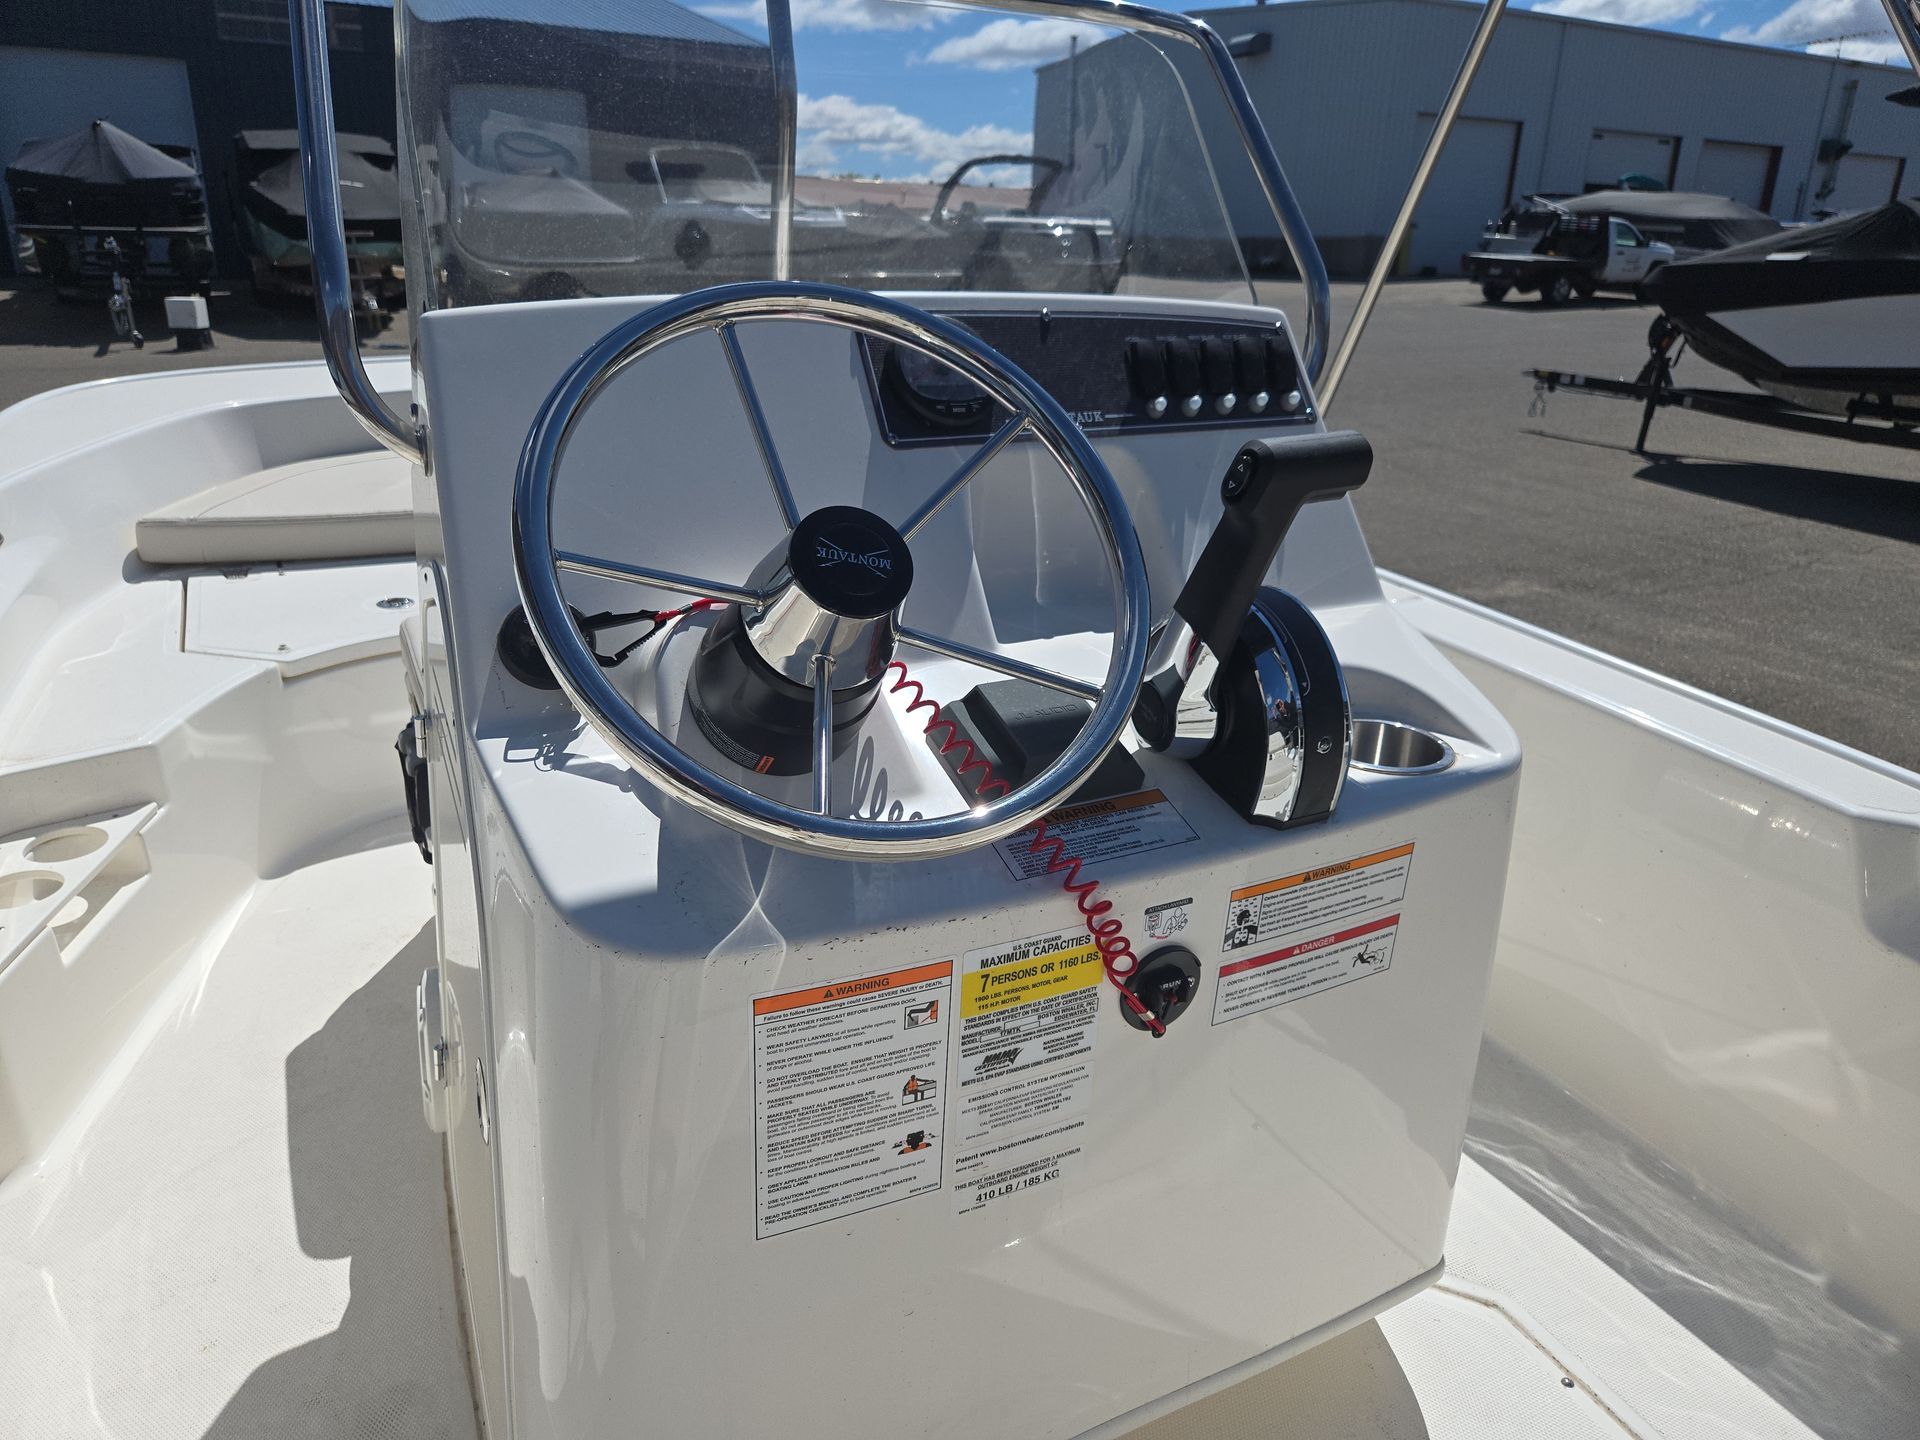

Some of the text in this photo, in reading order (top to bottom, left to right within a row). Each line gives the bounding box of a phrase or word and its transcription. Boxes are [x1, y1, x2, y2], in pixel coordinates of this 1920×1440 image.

[816, 546, 892, 570] MONTAUK
[1035, 704, 1078, 716] AUDIO
[1052, 802, 1116, 821] WARNING
[1312, 862, 1350, 879] WARNING
[980, 934, 1090, 969] MAXIMUM CAPACITIES
[1024, 939, 1041, 948] COAST
[1043, 935, 1061, 943] GUARD
[1300, 935, 1335, 952] DANGER
[980, 950, 1100, 992] 7 PERSONS OR 1160 LBS.
[837, 978, 889, 995] WARNING
[1003, 984, 1030, 995] PERSONS,
[1052, 975, 1067, 983] GEAR
[1162, 980, 1182, 990] RUN
[764, 1013, 781, 1022] Failure
[789, 1008, 805, 1016] follow
[806, 1005, 820, 1013] these
[822, 1000, 845, 1010] warnings
[846, 997, 860, 1005] could
[862, 994, 876, 1002] cause
[878, 989, 898, 998] SEVERE
[899, 985, 917, 994] INJURY
[787, 1019, 814, 1028] WEATHER
[816, 1013, 845, 1022] FORECAST
[846, 1008, 868, 1016] BEFORE
[870, 1001, 899, 1011] DEPARTING
[900, 997, 915, 1005] DOCK
[964, 1019, 994, 1031] STANDARDS
[1002, 1012, 1020, 1021] EFFECT
[1030, 1006, 1039, 1014] THE
[1062, 992, 1097, 1005] CERTIFICATION
[965, 1016, 976, 1024] THIS
[992, 1006, 1018, 1017] COMPLIES
[1019, 1002, 1031, 1010] WITH
[1043, 996, 1059, 1004] COAST
[1060, 991, 1077, 999] GUARD
[1079, 986, 1096, 994] SAFETY
[978, 1003, 988, 1011] 115
[1000, 995, 1020, 1004] MOTOR
[1037, 1010, 1059, 1019] BOSTON
[766, 1032, 833, 1050] WEAR SAFETY LANYARD
[787, 1053, 812, 1062] OPERATE
[832, 1044, 851, 1052] UNDER
[864, 1035, 892, 1045] INFLUENCE
[776, 1074, 788, 1082] NOT
[789, 1068, 819, 1078] OVERLOAD
[873, 1052, 886, 1060] THAT
[888, 1048, 907, 1056] WEIGHT
[915, 1040, 941, 1050] PROPERLY
[767, 1092, 803, 1104] PASSENGERS
[805, 1086, 827, 1095] SHOULD
[829, 1082, 844, 1090] WEAR
[876, 1071, 894, 1079] GUARD
[896, 1064, 923, 1074] APPROVED
[780, 1077, 801, 1085] EVENLY
[802, 1069, 837, 1080] DISTRIBUTED
[968, 1065, 1085, 1103] EMISSIONS CONTROL SYSTEM INFORMATION
[956, 1152, 977, 1164] Patent
[979, 1121, 1084, 1157] www.bostonwhaler.com/patents
[783, 1160, 805, 1169] PROPER
[806, 1153, 832, 1163] LOOKOUT
[845, 1146, 859, 1154] SAFE
[954, 1182, 966, 1190] THIS
[968, 1177, 982, 1186] BOAT
[983, 1173, 995, 1181] HAS
[996, 1168, 1010, 1178] BEEN
[1012, 1160, 1038, 1173] DESIGNED
[1039, 1157, 1050, 1165] FOR
[1056, 1148, 1080, 1160] MAXIMUM
[784, 1173, 817, 1185] APPLICABLE
[818, 1164, 849, 1176] NAVIGATION
[977, 1175, 1007, 1189] OUTBOARD
[1009, 1169, 1028, 1180] ENGINE
[1030, 1163, 1049, 1174] WEIGHT
[768, 1184, 791, 1194] BOATING
[818, 1196, 839, 1206] MANUAL
[853, 1186, 880, 1196] COMPLETE
[976, 1188, 994, 1202] 410
[998, 1183, 1012, 1194] LB
[1015, 1181, 1019, 1189] /
[1022, 1174, 1040, 1187] 185
[765, 1202, 837, 1225] PRE-OPERATION CHECKLIST
